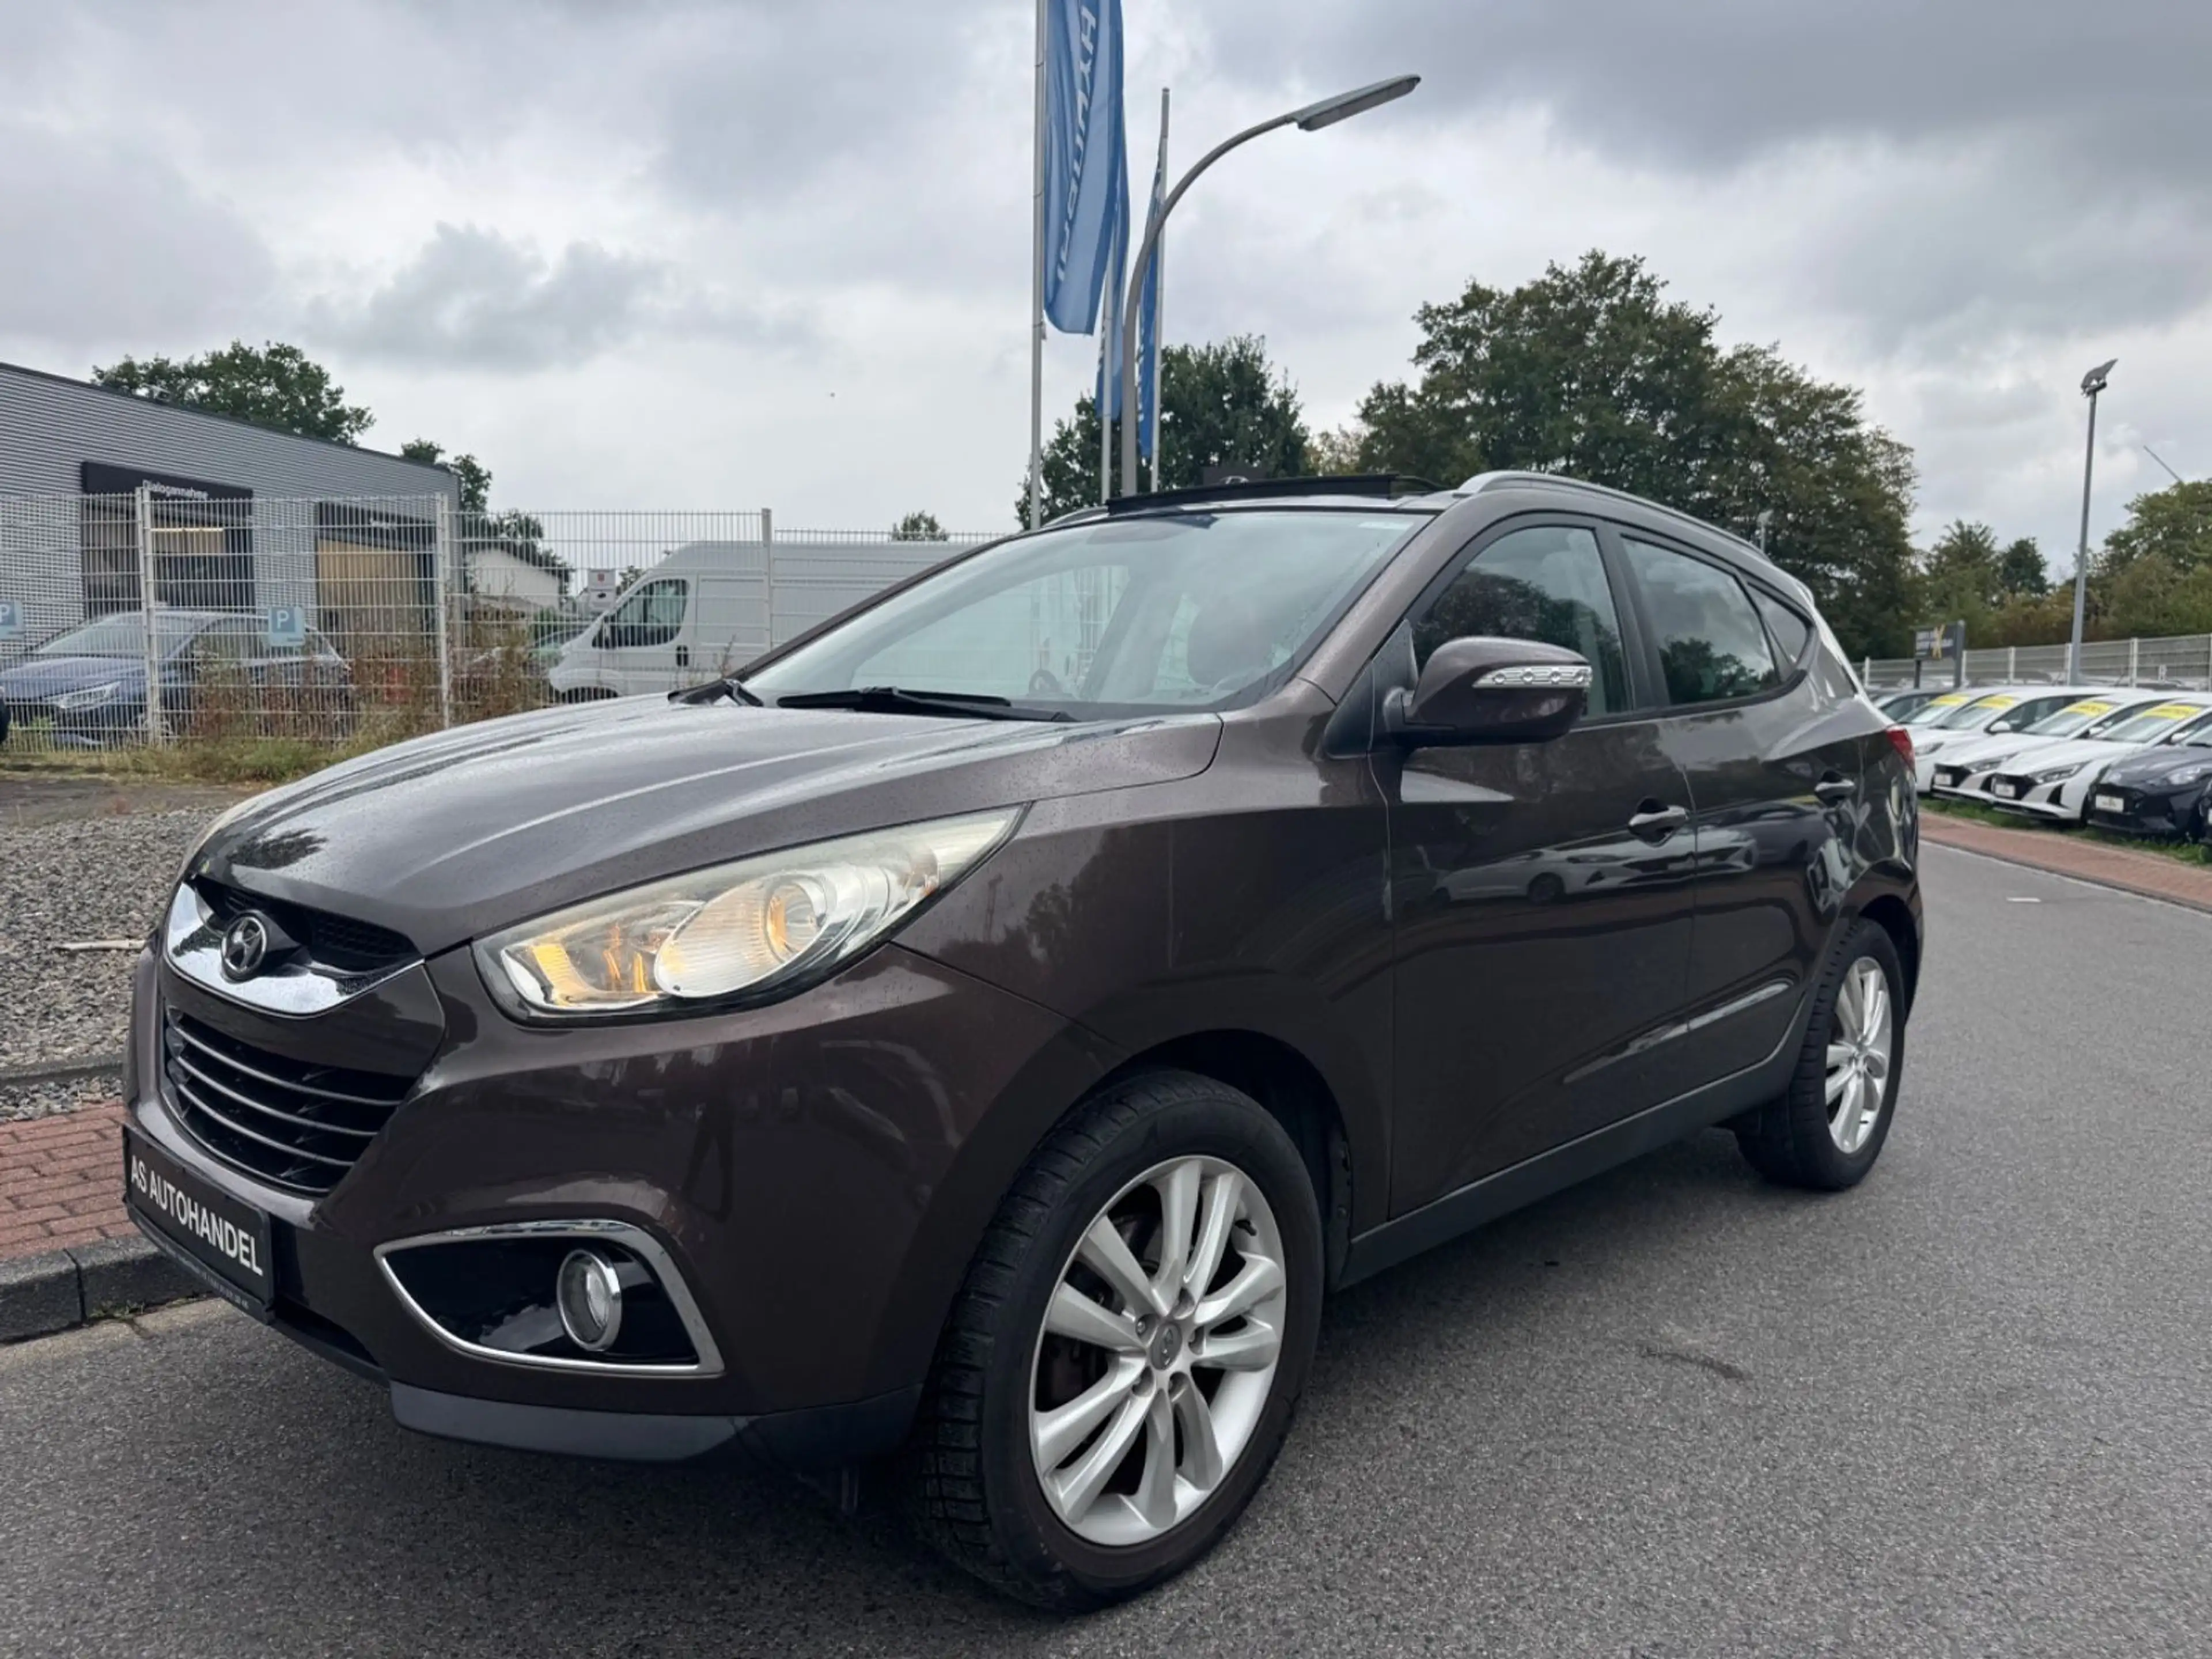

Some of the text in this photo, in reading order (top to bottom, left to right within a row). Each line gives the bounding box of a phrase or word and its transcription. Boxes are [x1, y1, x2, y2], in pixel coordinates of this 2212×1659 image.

[1056, 6, 1097, 282] HYUNDAI
[276, 610, 290, 629] P
[131, 1154, 147, 1194] AS
[150, 1170, 264, 1277] AUTOHANDEL
